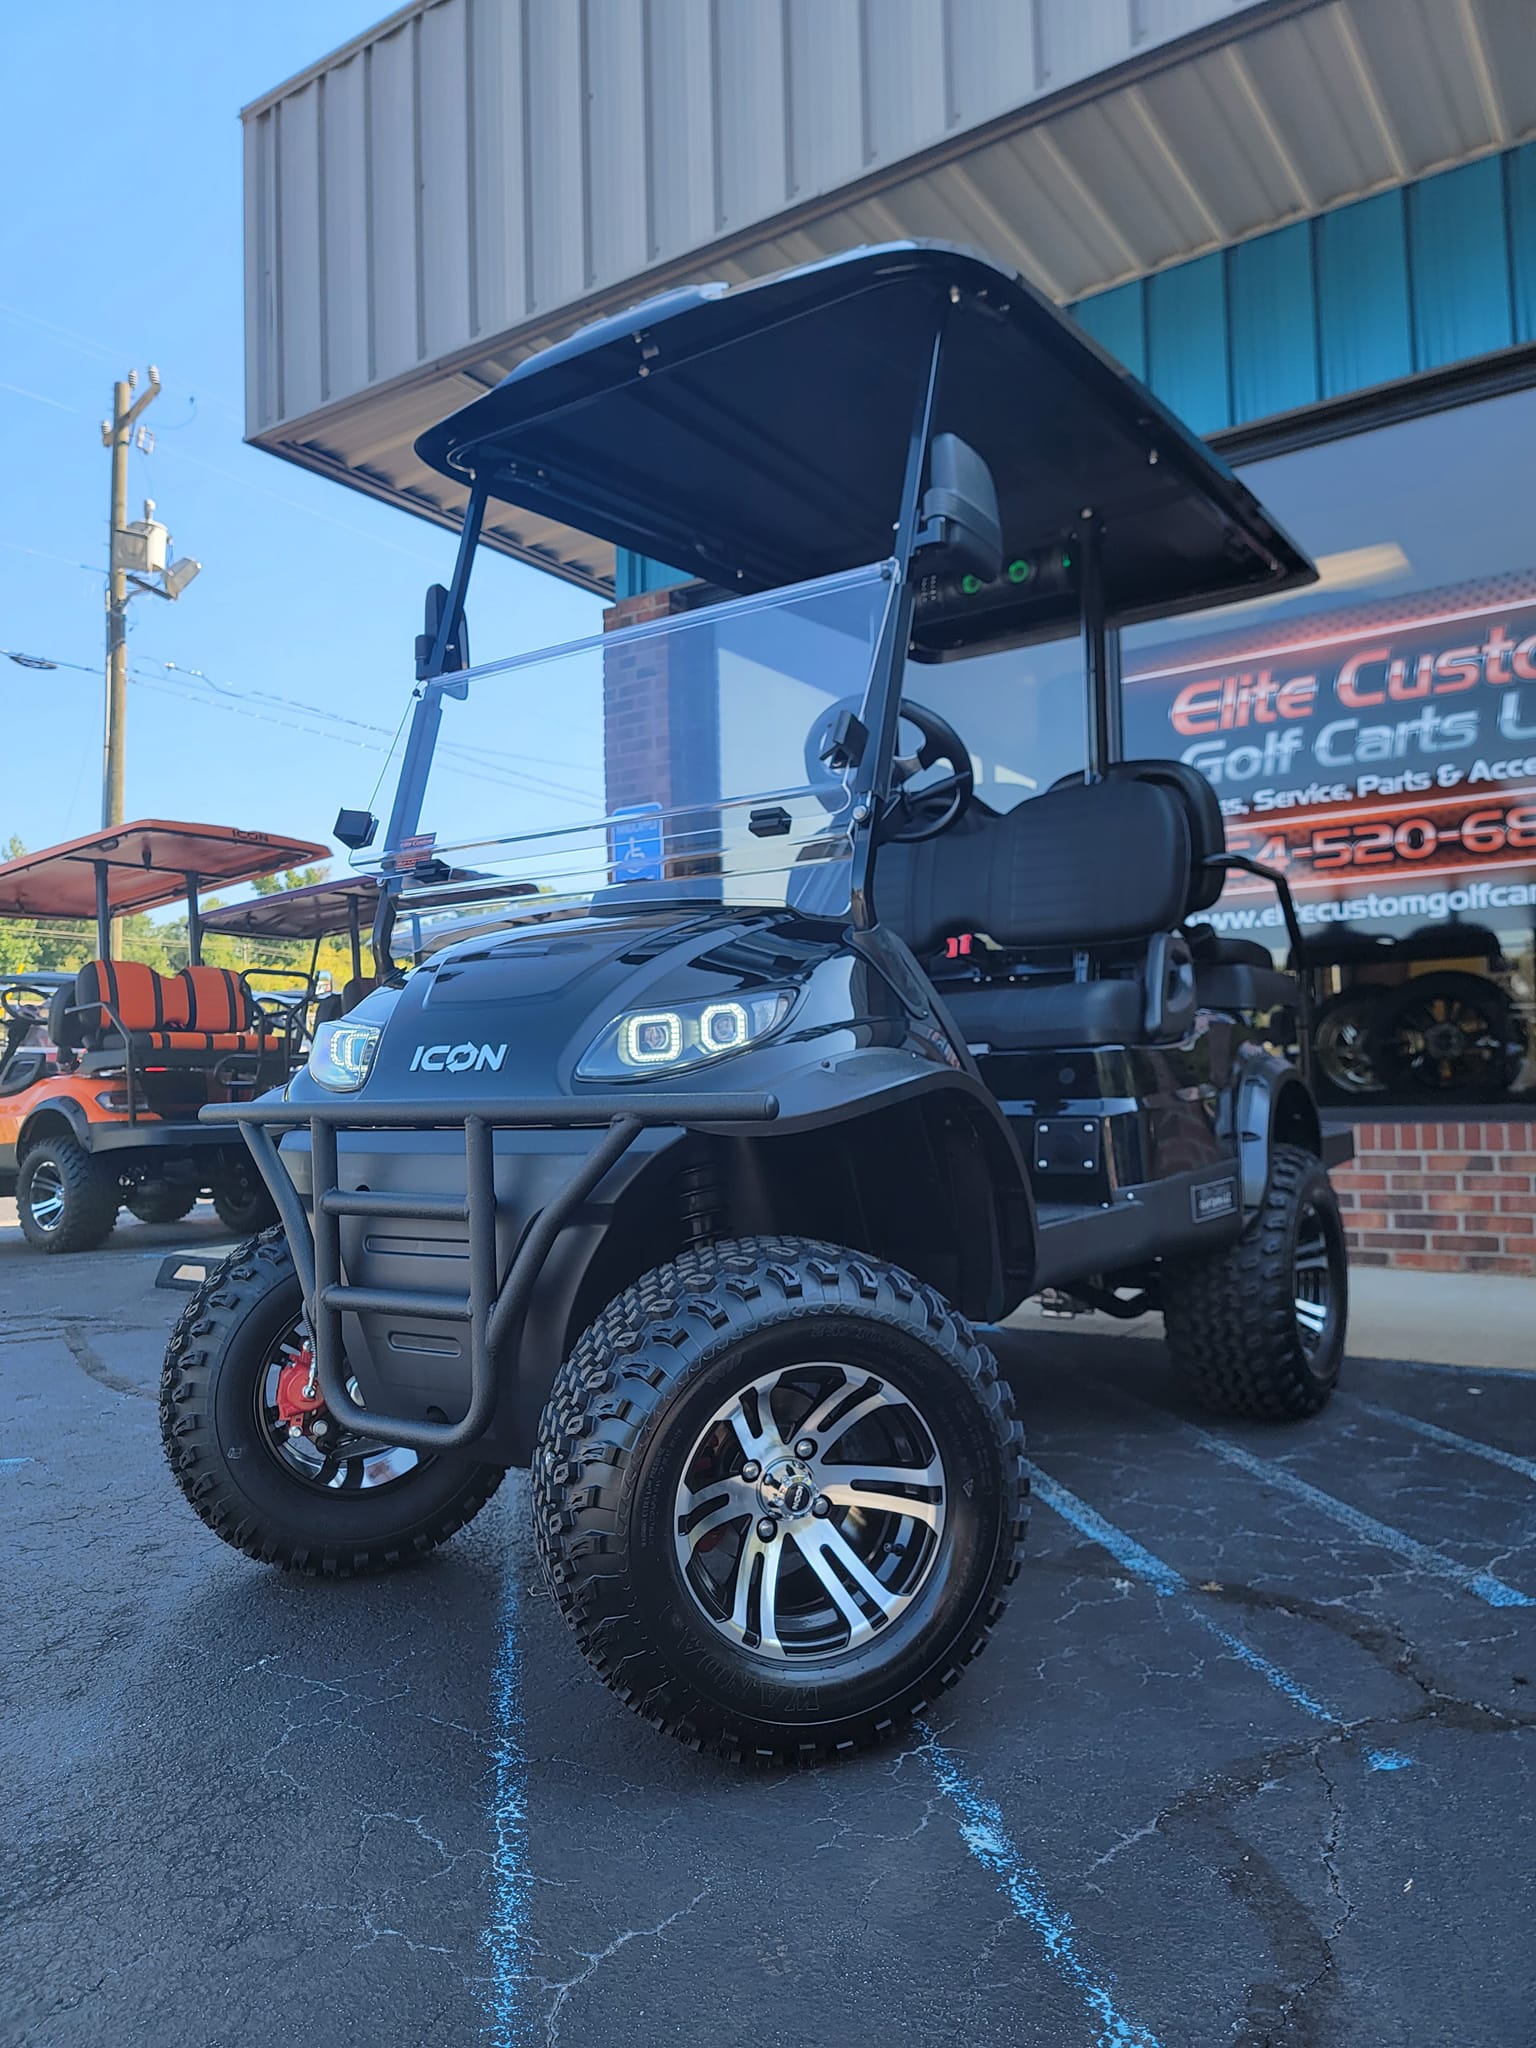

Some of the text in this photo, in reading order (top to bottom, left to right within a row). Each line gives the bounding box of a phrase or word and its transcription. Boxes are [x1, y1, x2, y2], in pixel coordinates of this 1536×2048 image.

[1169, 624, 1536, 736] Elite Custo
[1180, 726, 1304, 785] Golf
[1313, 704, 1479, 768] Carts
[1253, 782, 1354, 812] Service,
[1356, 768, 1432, 798] Parts
[1437, 763, 1464, 788] &
[409, 1041, 508, 1073] ICON
[791, 1485, 804, 1510] ICON
